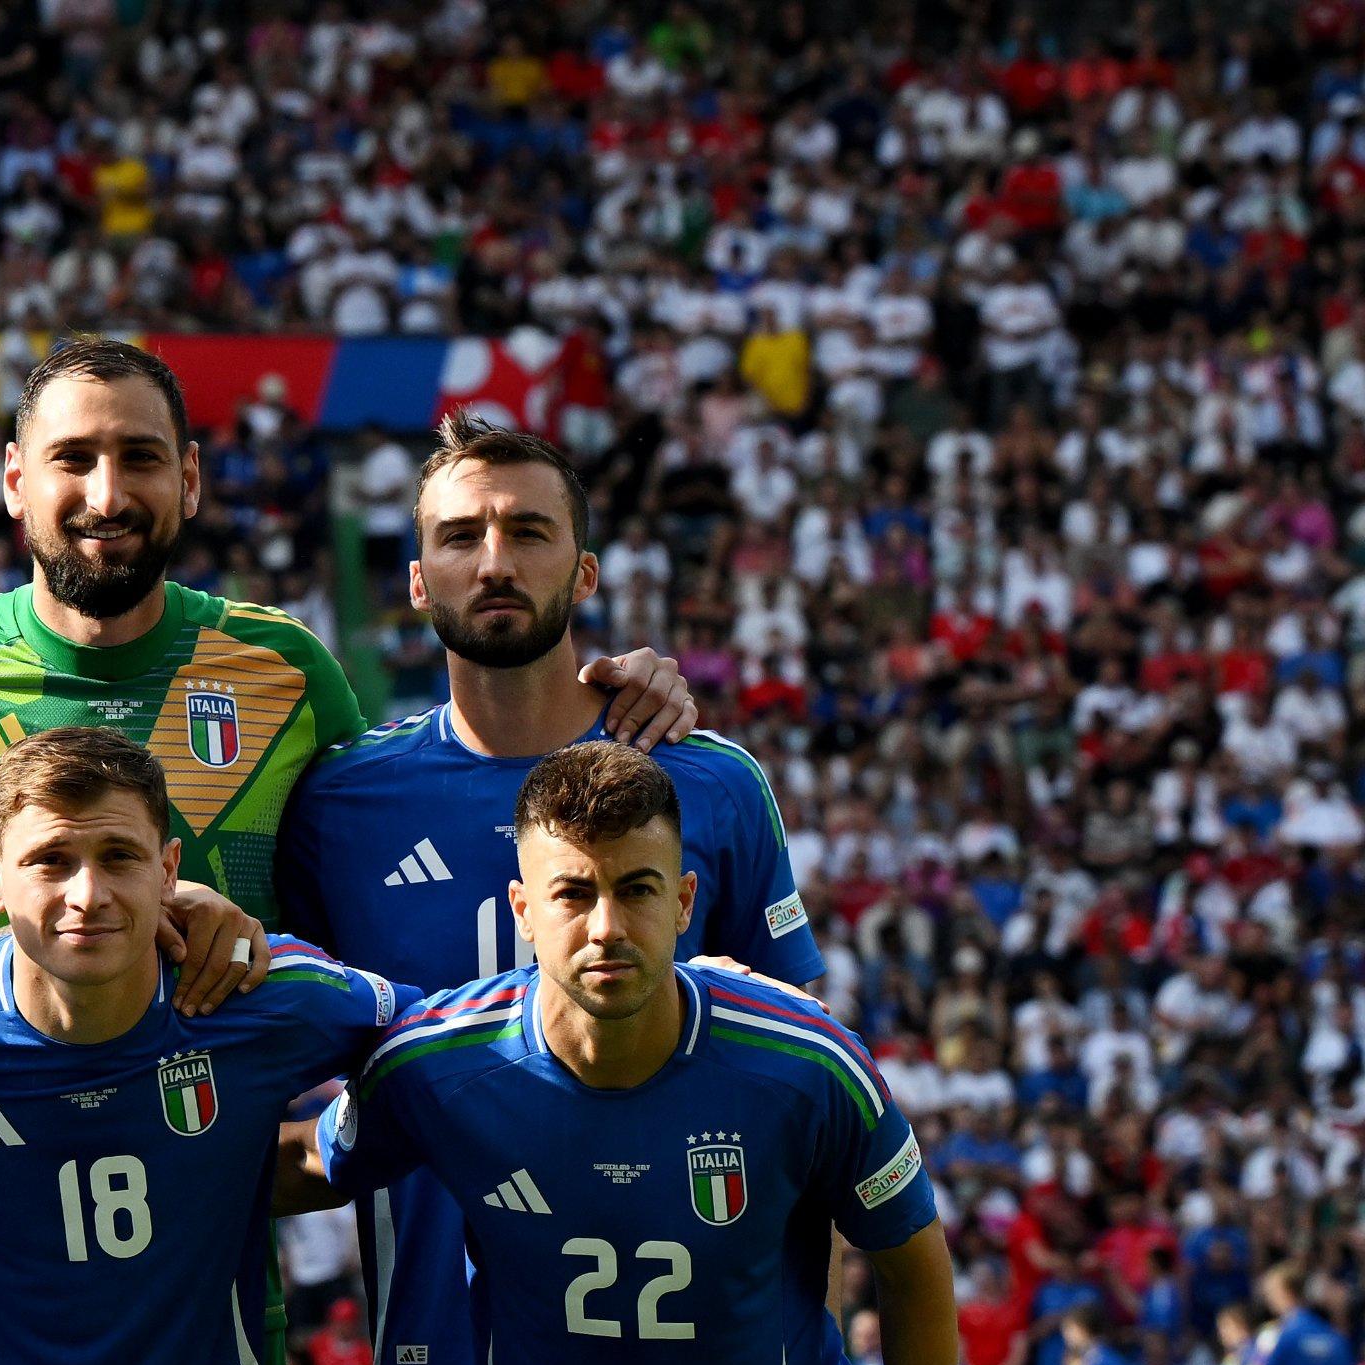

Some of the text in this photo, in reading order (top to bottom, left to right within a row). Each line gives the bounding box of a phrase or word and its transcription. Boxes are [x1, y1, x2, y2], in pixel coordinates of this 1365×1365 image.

[190, 698, 233, 715] ITALIA
[477, 896, 536, 978] 1
[163, 1062, 208, 1084] ITALIA
[692, 1152, 739, 1169] ITALIA
[58, 1155, 153, 1262] 18
[561, 1237, 696, 1340] 22
